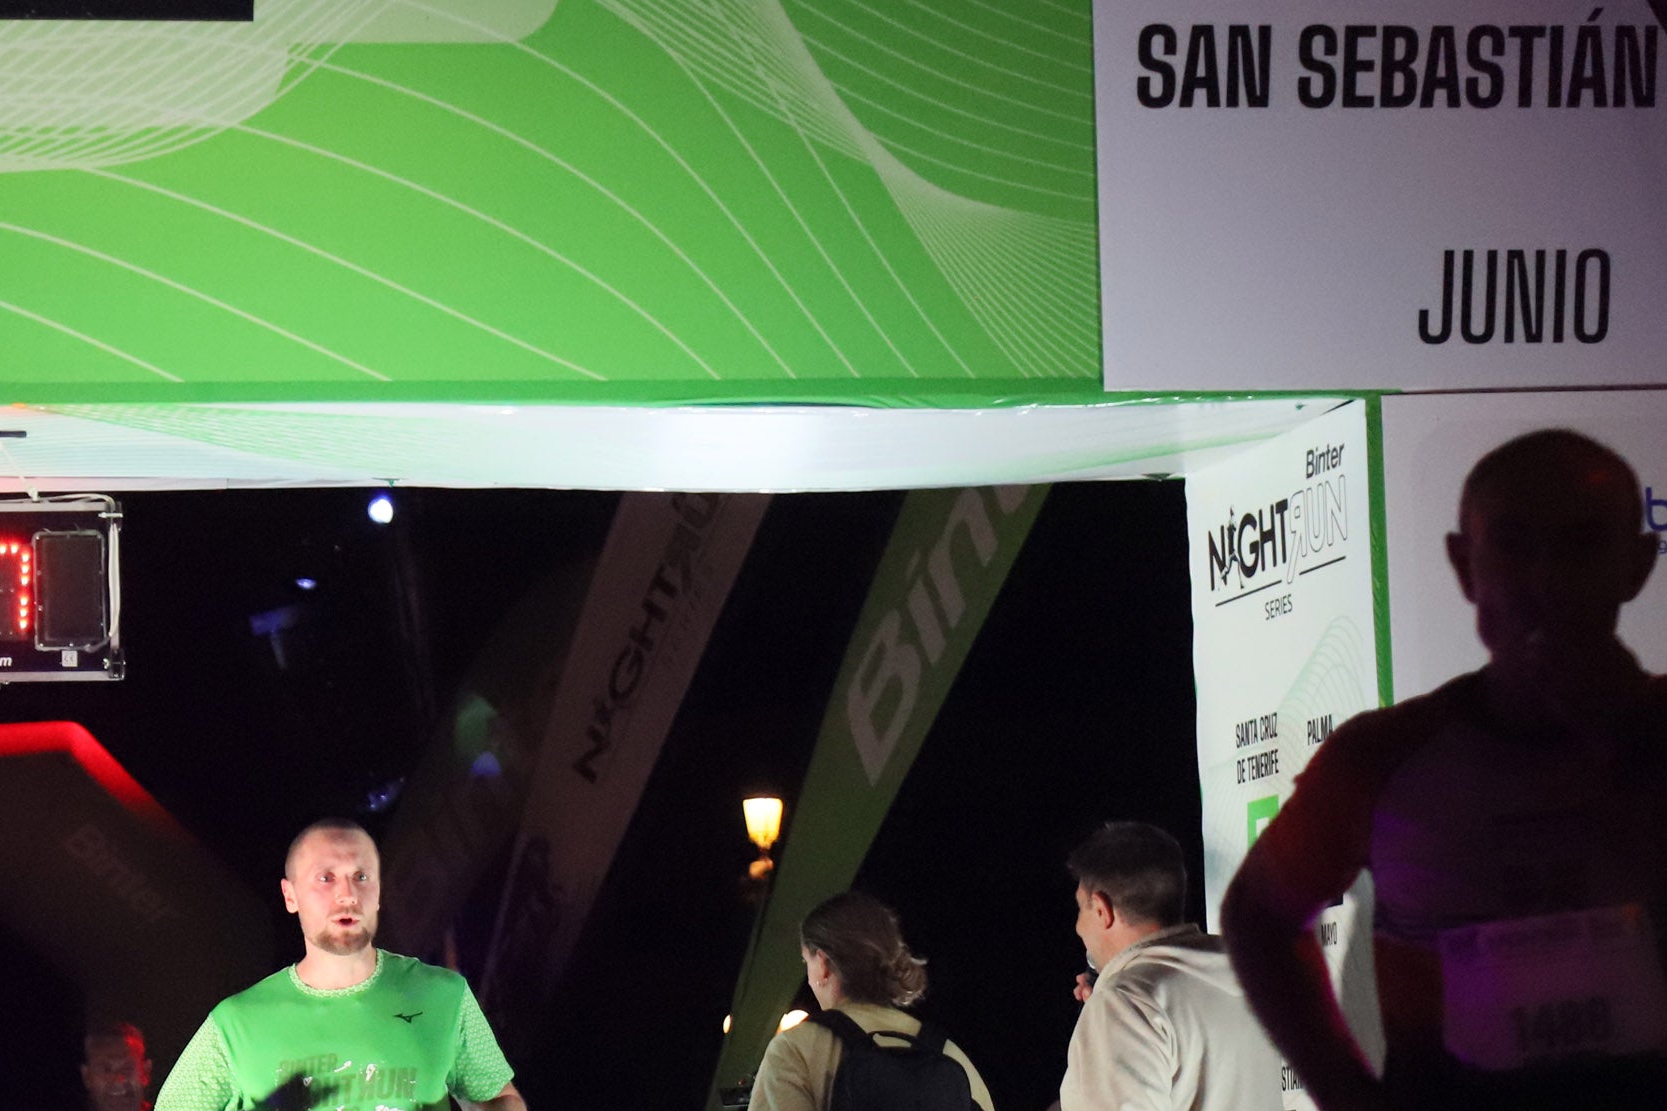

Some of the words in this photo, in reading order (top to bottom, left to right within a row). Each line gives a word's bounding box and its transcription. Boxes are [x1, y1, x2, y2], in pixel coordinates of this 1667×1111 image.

[1136, 23, 1272, 108] SAN
[1296, 8, 1658, 108] SEBASTIÁN
[1418, 248, 1612, 344] JUNIO
[1305, 443, 1345, 479] Binter
[1264, 593, 1293, 620] SERIES
[1235, 718, 1259, 749] SANTA
[1259, 712, 1278, 742] CRUZ
[1237, 758, 1246, 784] DE
[1247, 749, 1279, 781] TENERIFE
